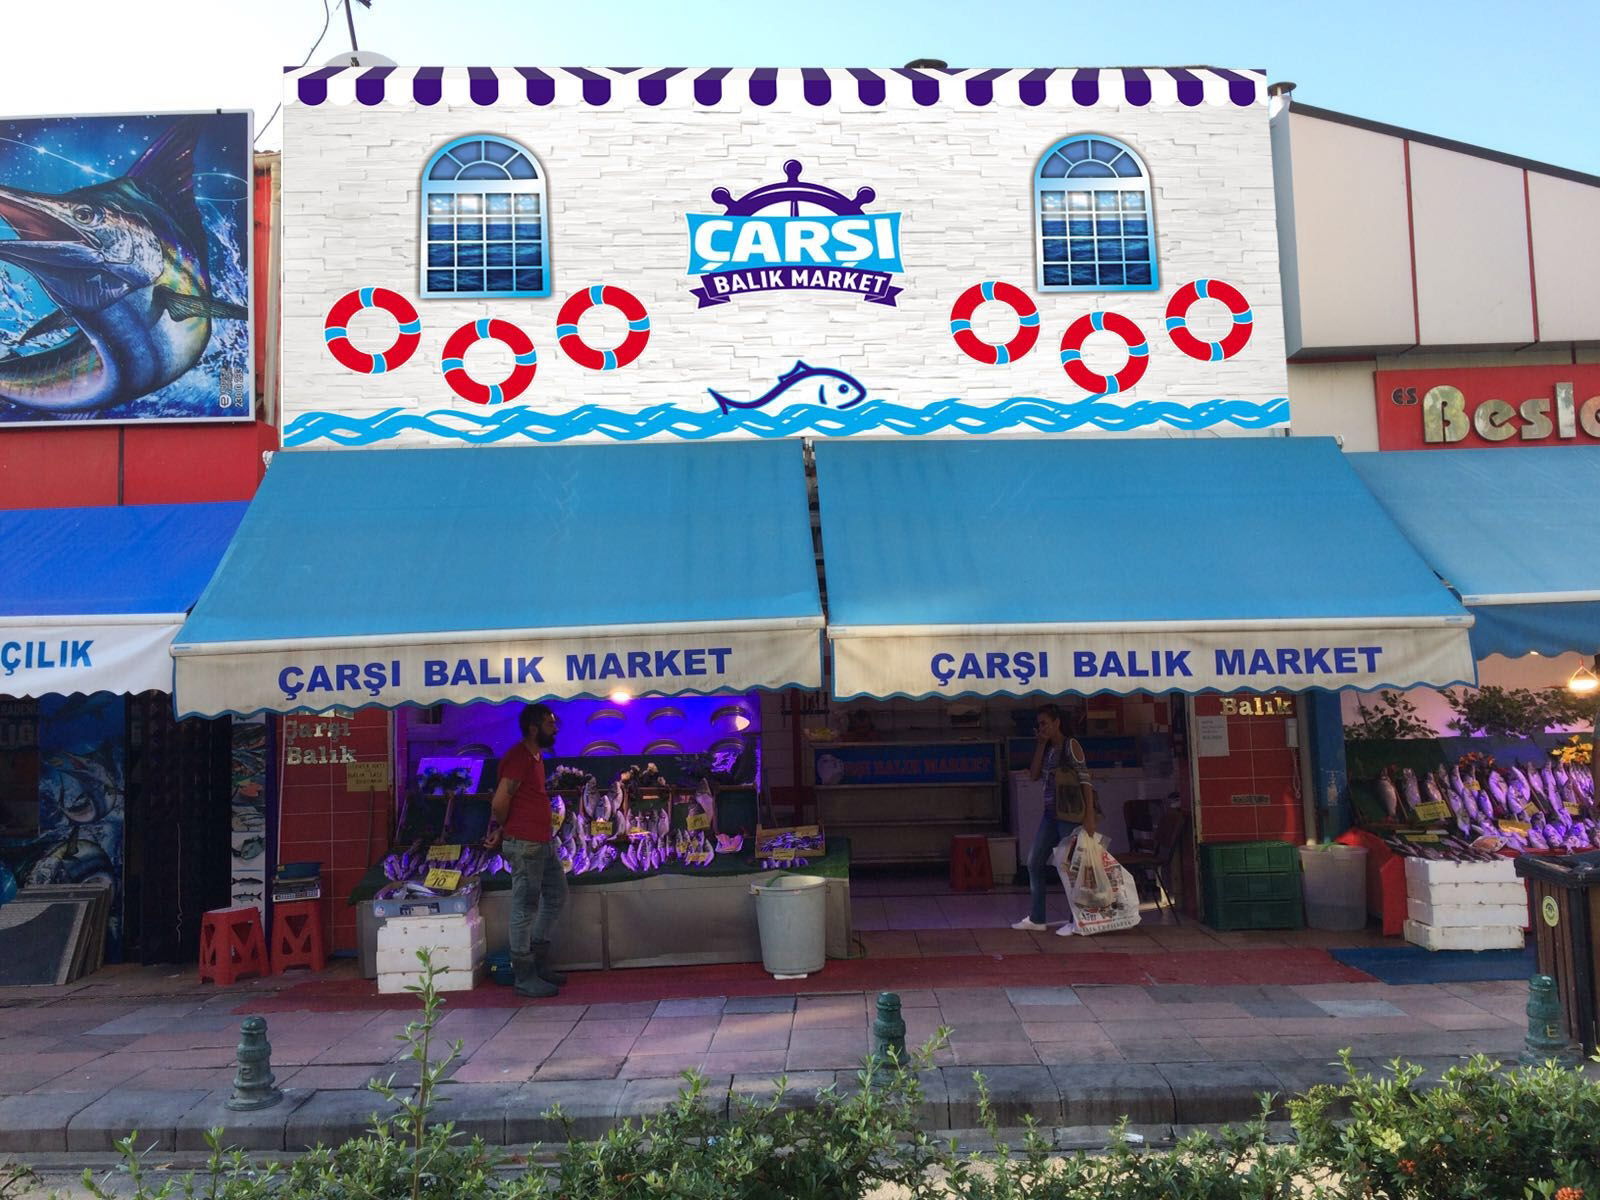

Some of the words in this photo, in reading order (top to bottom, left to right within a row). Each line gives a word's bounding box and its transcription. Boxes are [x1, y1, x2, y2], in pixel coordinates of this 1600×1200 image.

[694, 218, 896, 274] ÇARŞI
[713, 269, 785, 294] BALIK
[790, 269, 888, 294] MARKET
[278, 660, 400, 701] ÇARŞI
[424, 656, 545, 688] BALIK
[565, 647, 733, 682] MARKET
[931, 651, 1049, 687] ÇARŞI
[1074, 650, 1193, 679] BALIK
[1214, 646, 1384, 676] MARKET
